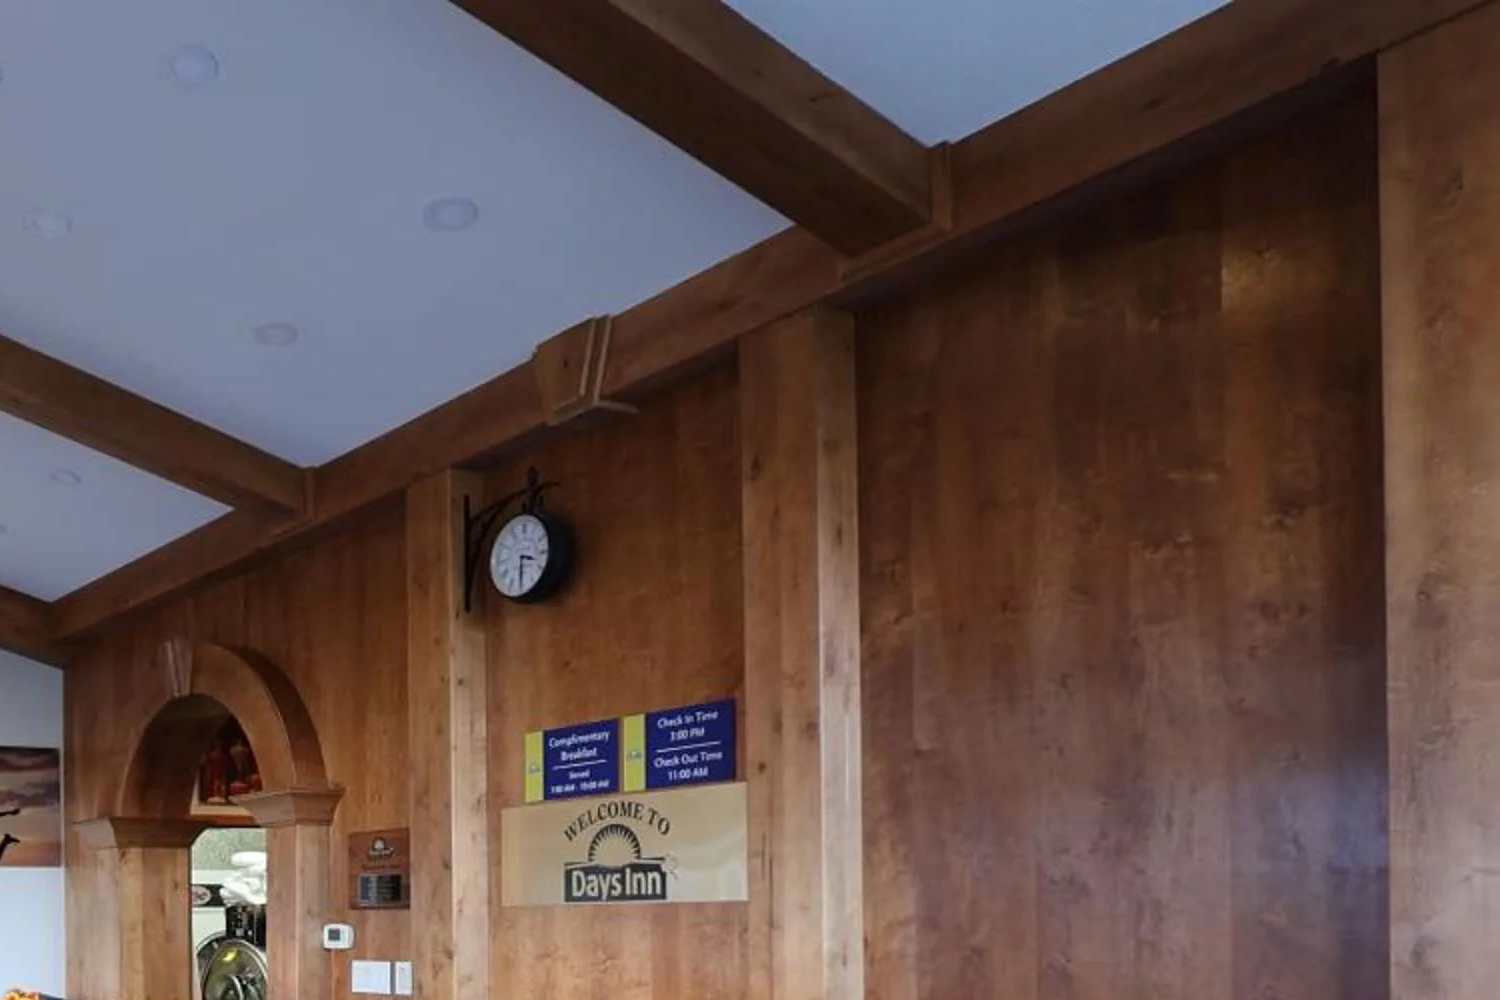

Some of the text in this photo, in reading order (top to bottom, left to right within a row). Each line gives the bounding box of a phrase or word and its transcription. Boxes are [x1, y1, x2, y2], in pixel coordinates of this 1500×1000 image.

[657, 710, 719, 729] Check In Time
[549, 731, 610, 749] Complimentary
[690, 726, 705, 739] PM
[560, 747, 597, 761] Breakfast
[653, 751, 723, 769] Check Out Time
[668, 766, 709, 782] 11:00 AM
[564, 800, 671, 842] WELCOME TO
